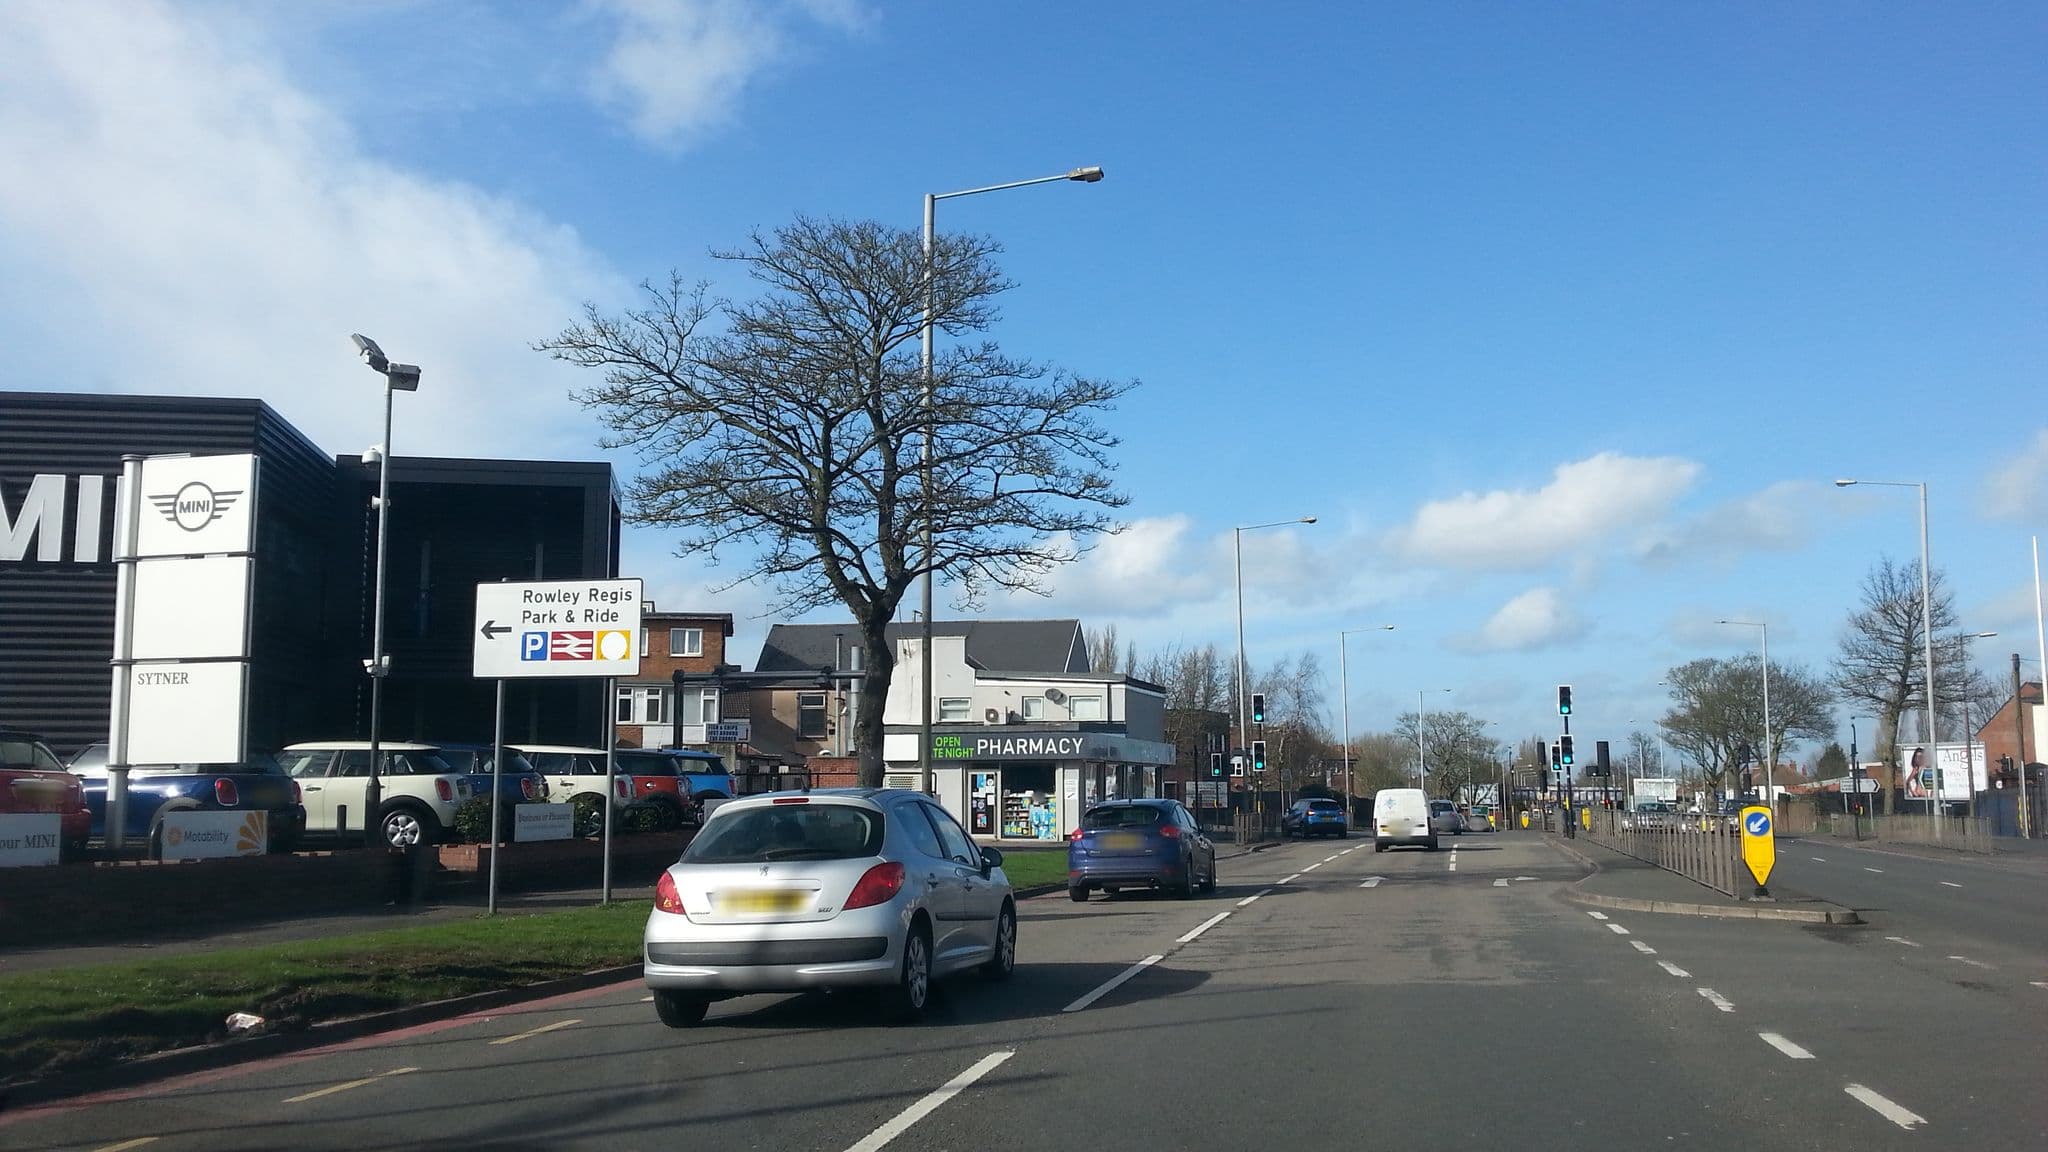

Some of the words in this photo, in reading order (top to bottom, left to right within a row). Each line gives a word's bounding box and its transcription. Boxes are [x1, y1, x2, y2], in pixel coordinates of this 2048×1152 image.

[178, 499, 211, 515] MINI
[0, 474, 125, 563] MI
[522, 589, 581, 606] Rowley
[589, 587, 633, 604] Regis
[521, 610, 558, 624] Park
[565, 609, 576, 624] &
[584, 608, 620, 623] Ride
[137, 672, 190, 686] SYTNER
[933, 748, 944, 758] TE
[945, 747, 975, 758] NIGHT
[935, 736, 961, 748] OPEN
[977, 737, 1084, 755] PHARMACY
[1943, 748, 1983, 770] Angls
[0, 839, 21, 849] our
[24, 833, 57, 849] MINI
[184, 829, 229, 845] Motability
